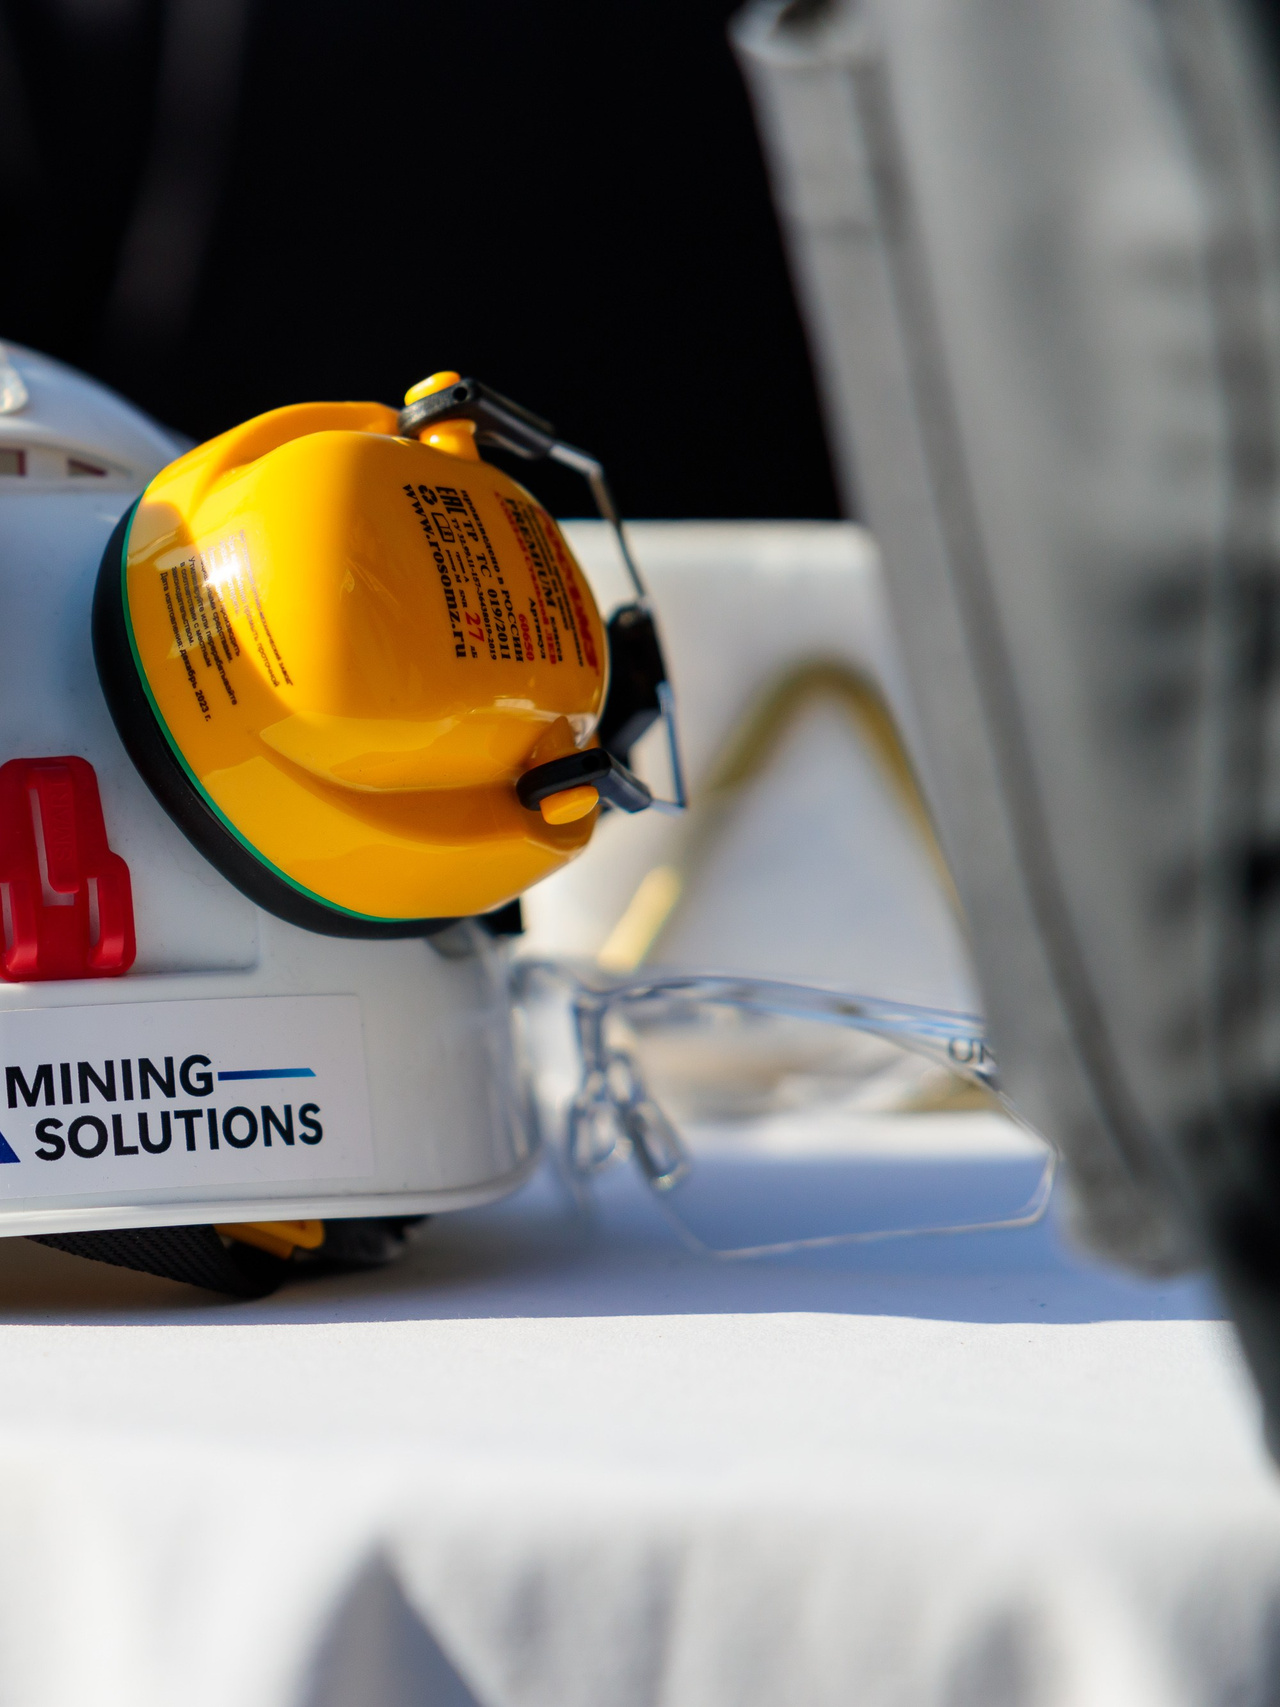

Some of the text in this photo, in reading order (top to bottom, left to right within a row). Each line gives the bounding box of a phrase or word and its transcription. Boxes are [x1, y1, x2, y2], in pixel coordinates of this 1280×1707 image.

[450, 517, 462, 532] ТУ
[504, 497, 557, 608] PREMIUM
[159, 570, 171, 591] Дата
[401, 483, 468, 658] www.rosomz.ru
[460, 489, 523, 663] произведено в РОССИИ
[462, 521, 512, 659] ТР ТС 019/2011
[164, 592, 185, 648] изготовления:
[172, 566, 196, 645] законодательством.
[181, 568, 198, 621] соответствии
[195, 629, 213, 667] местным
[189, 556, 239, 705] Утилизируйте или перерабатывайте
[457, 588, 468, 608] SNR
[463, 610, 485, 642] 27
[528, 597, 547, 659] Артикул
[212, 610, 234, 663] средствами.
[244, 604, 281, 687] промыть проточной
[517, 614, 535, 661] 60650
[542, 628, 558, 665] ЛЕВ
[195, 689, 210, 713] 2023
[204, 713, 212, 722] г.
[5, 1054, 214, 1108] MINING
[34, 1102, 324, 1162] SOLUTIONS
